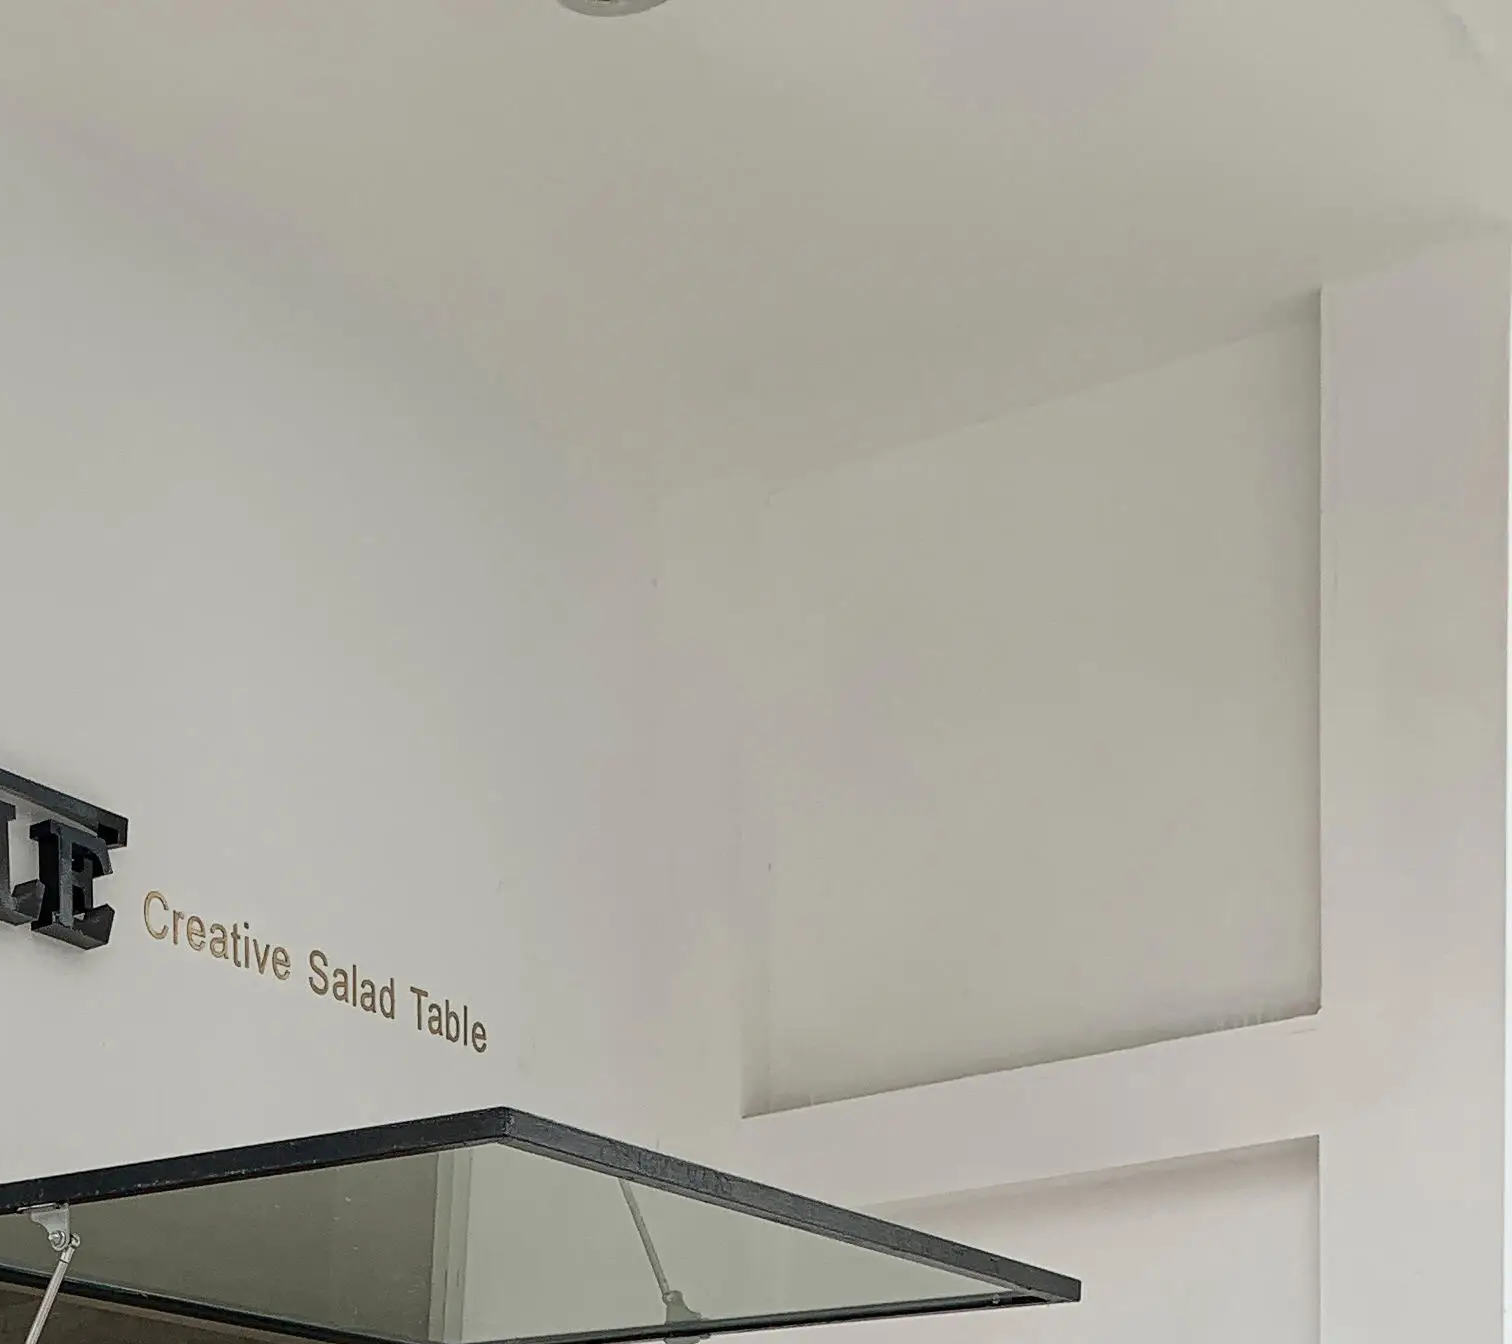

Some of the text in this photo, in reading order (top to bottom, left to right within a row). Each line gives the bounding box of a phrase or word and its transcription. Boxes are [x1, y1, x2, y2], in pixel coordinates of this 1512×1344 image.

[143, 890, 488, 1054] Creative Salad Table
